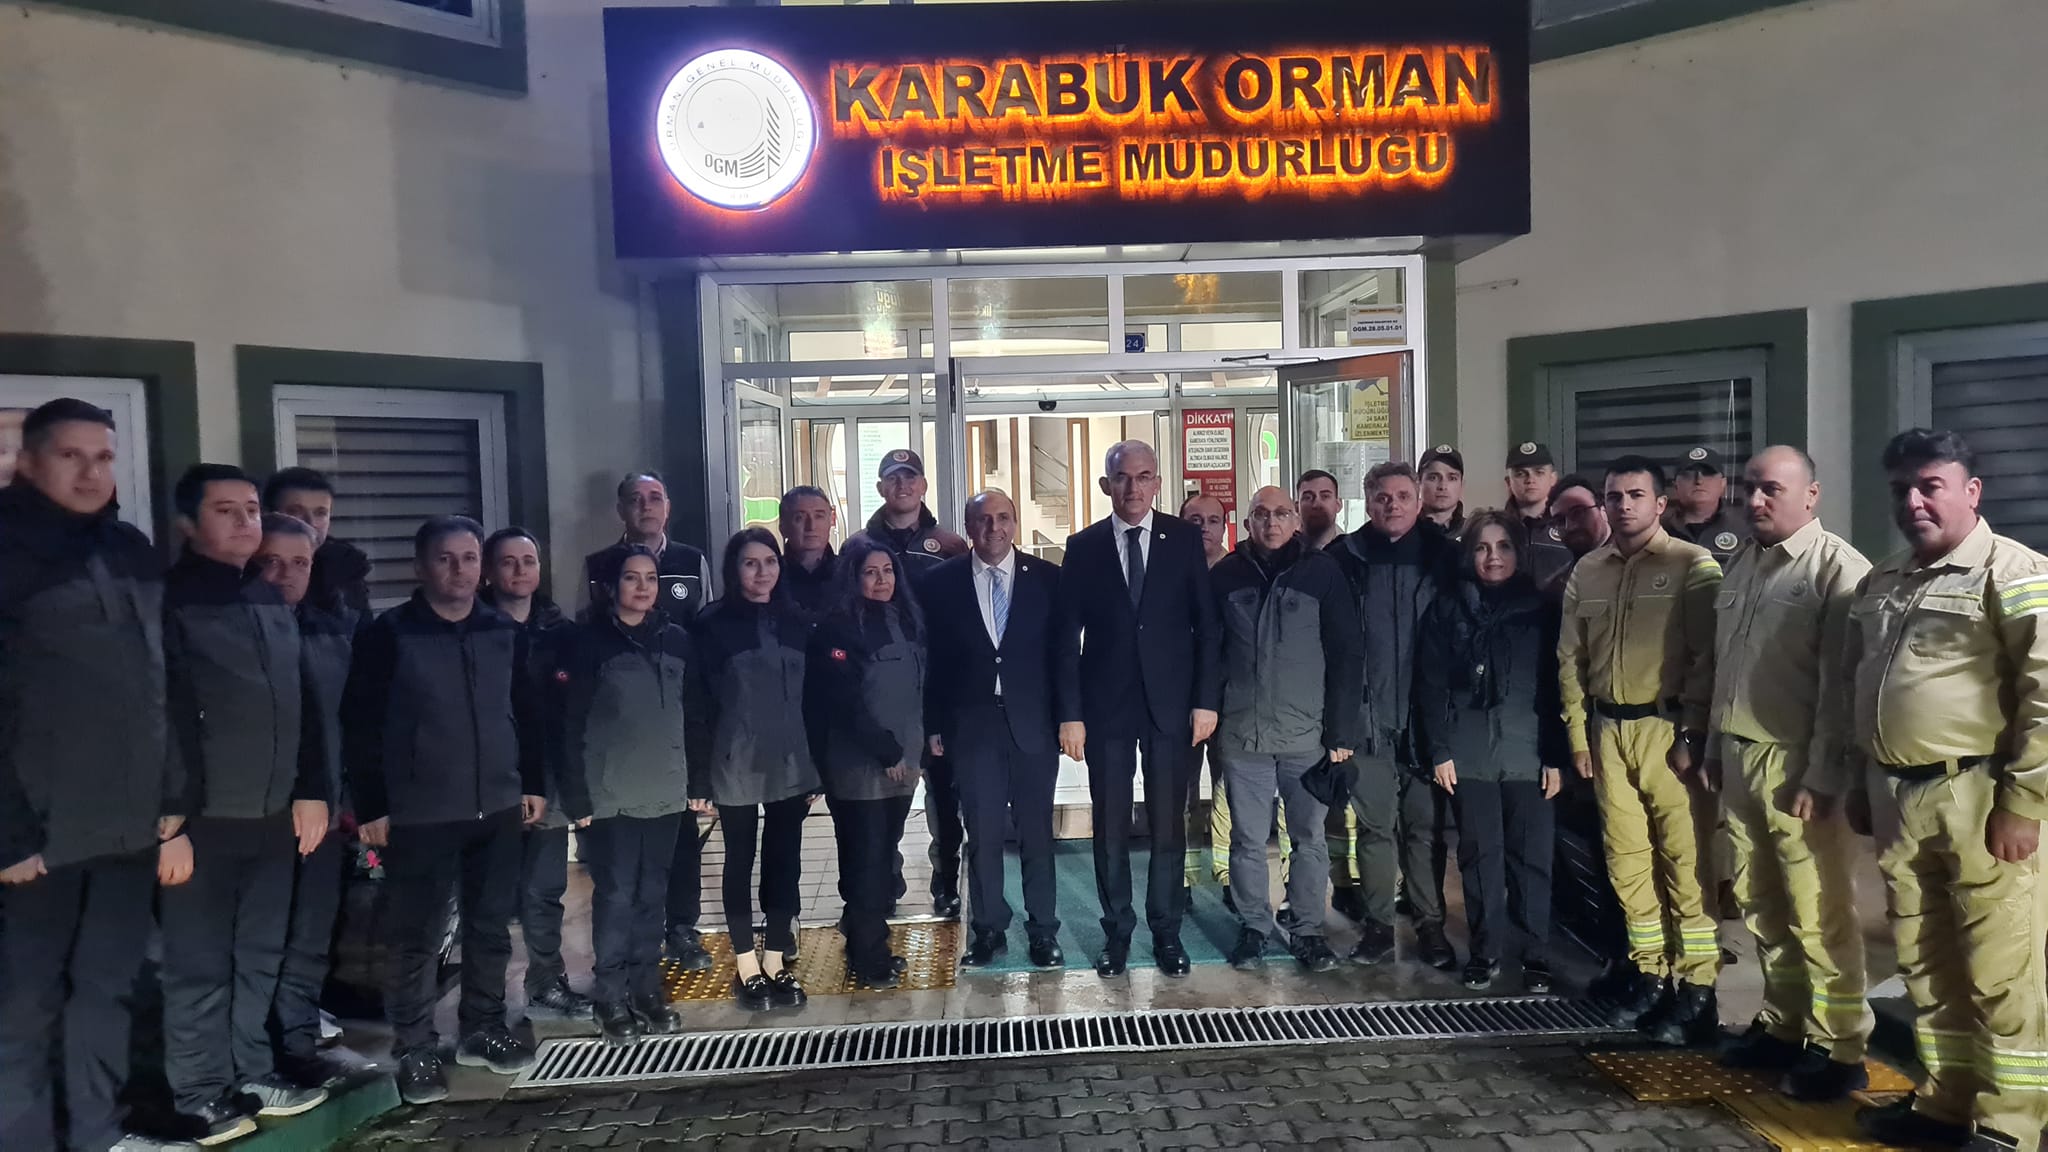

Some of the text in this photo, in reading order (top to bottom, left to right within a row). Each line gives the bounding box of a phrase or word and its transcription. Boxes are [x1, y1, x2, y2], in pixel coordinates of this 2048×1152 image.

[686, 58, 736, 84] GENEL
[833, 46, 1491, 123] KARABÜK ORMAN
[704, 153, 739, 178] OGM
[881, 138, 1102, 198] İŞLETME
[1126, 339, 1139, 348] 24
